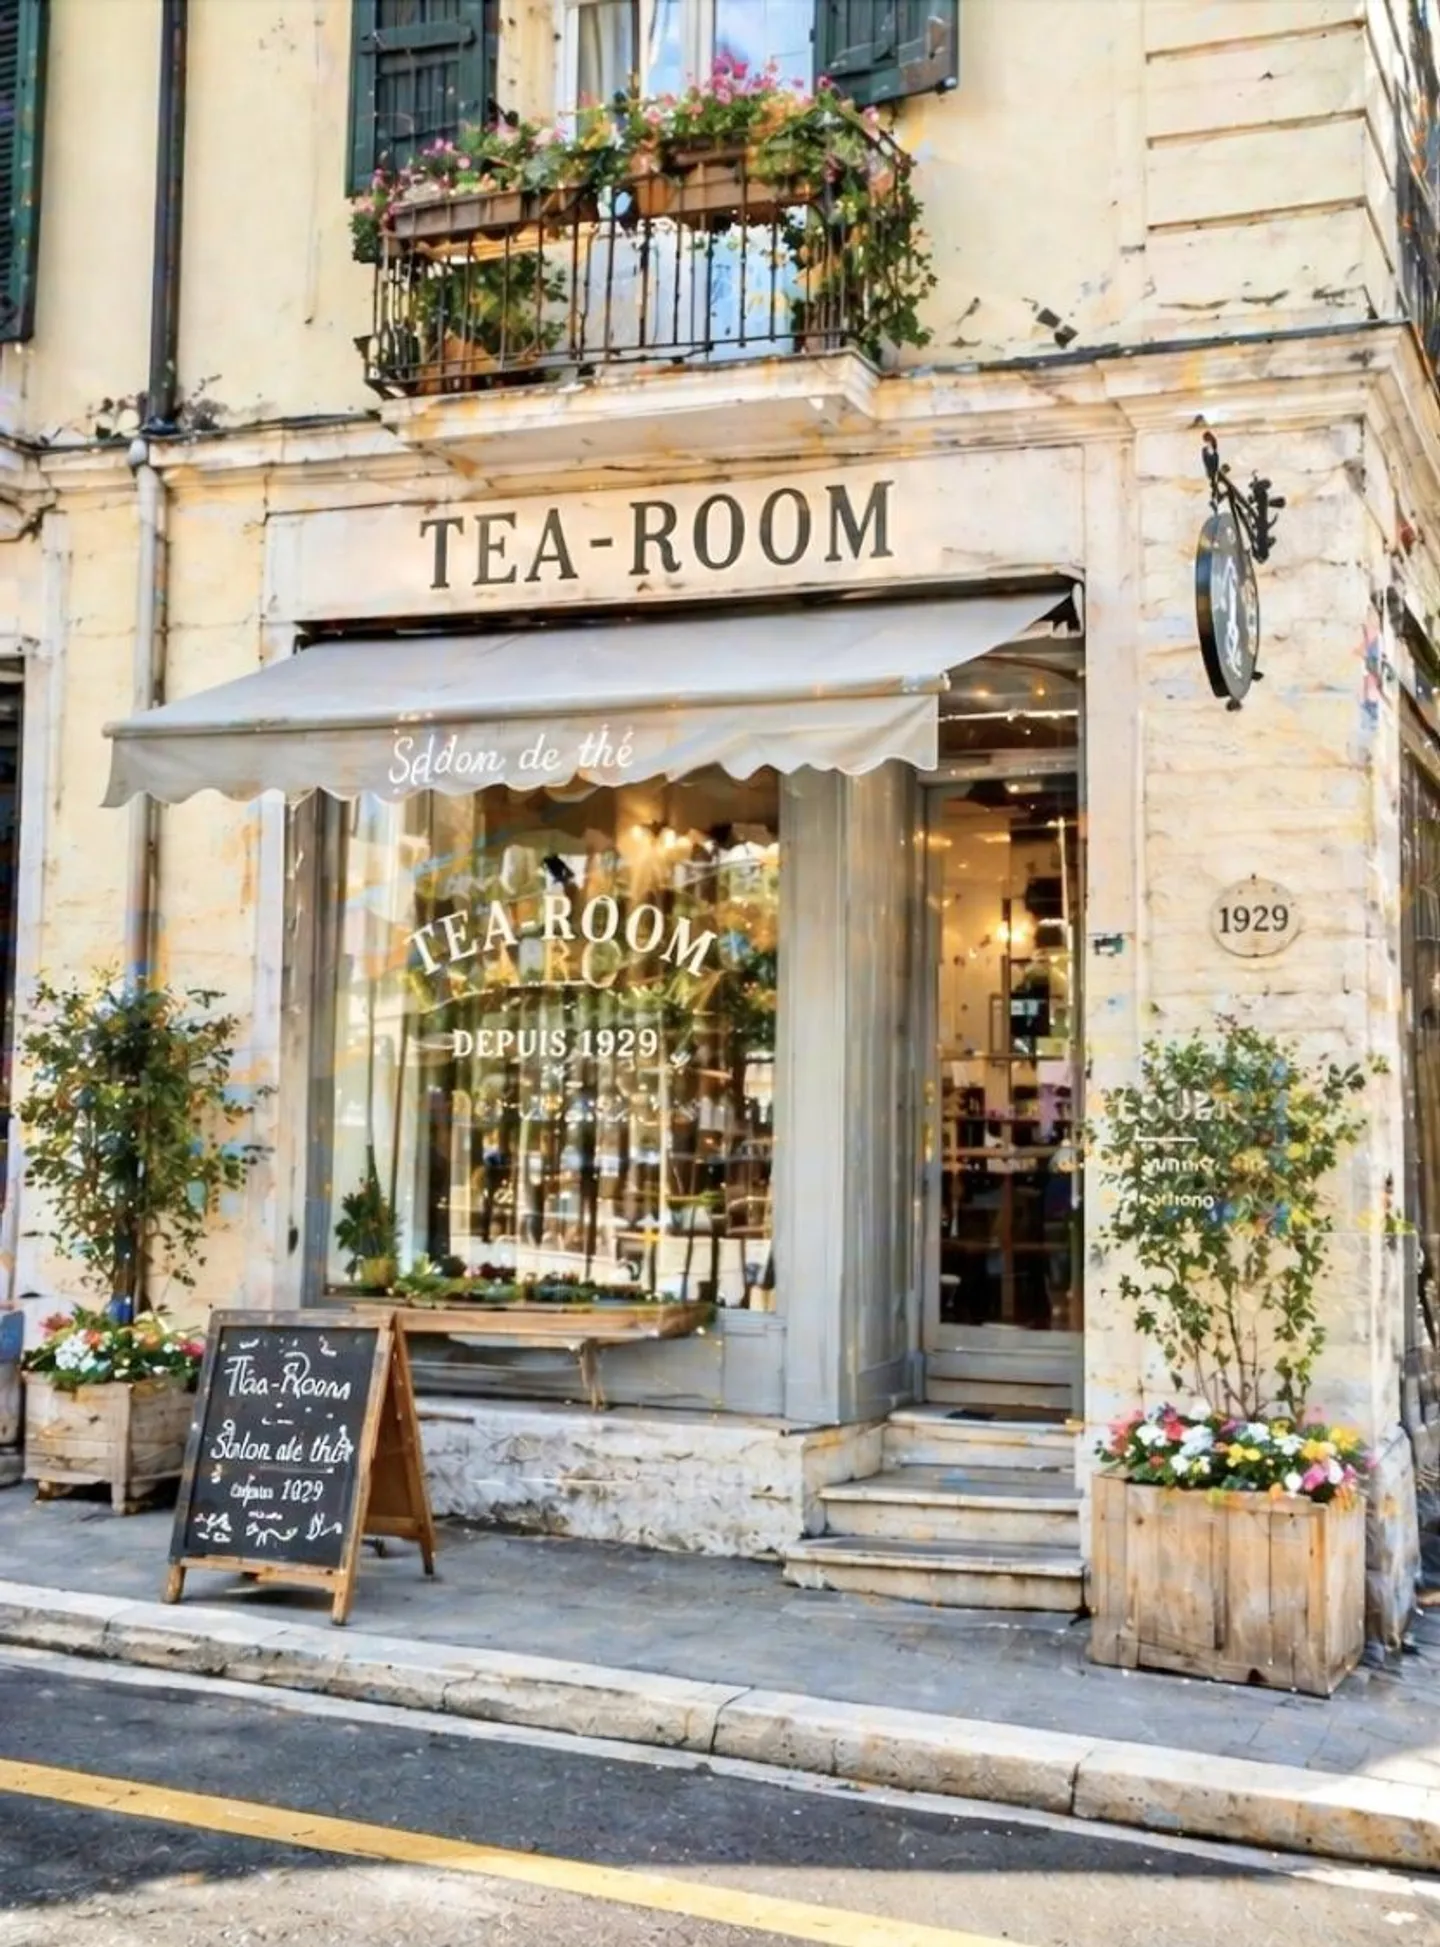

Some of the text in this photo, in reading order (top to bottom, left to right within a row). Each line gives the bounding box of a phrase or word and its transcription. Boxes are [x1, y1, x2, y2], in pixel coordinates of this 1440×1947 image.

[420, 479, 894, 589] TEA-ROOM
[518, 733, 563, 770] de
[577, 724, 635, 769] thé
[403, 894, 719, 977] TEA-ROOM
[1218, 904, 1289, 933] 1929
[452, 1028, 658, 1057] DEPUIS 1929
